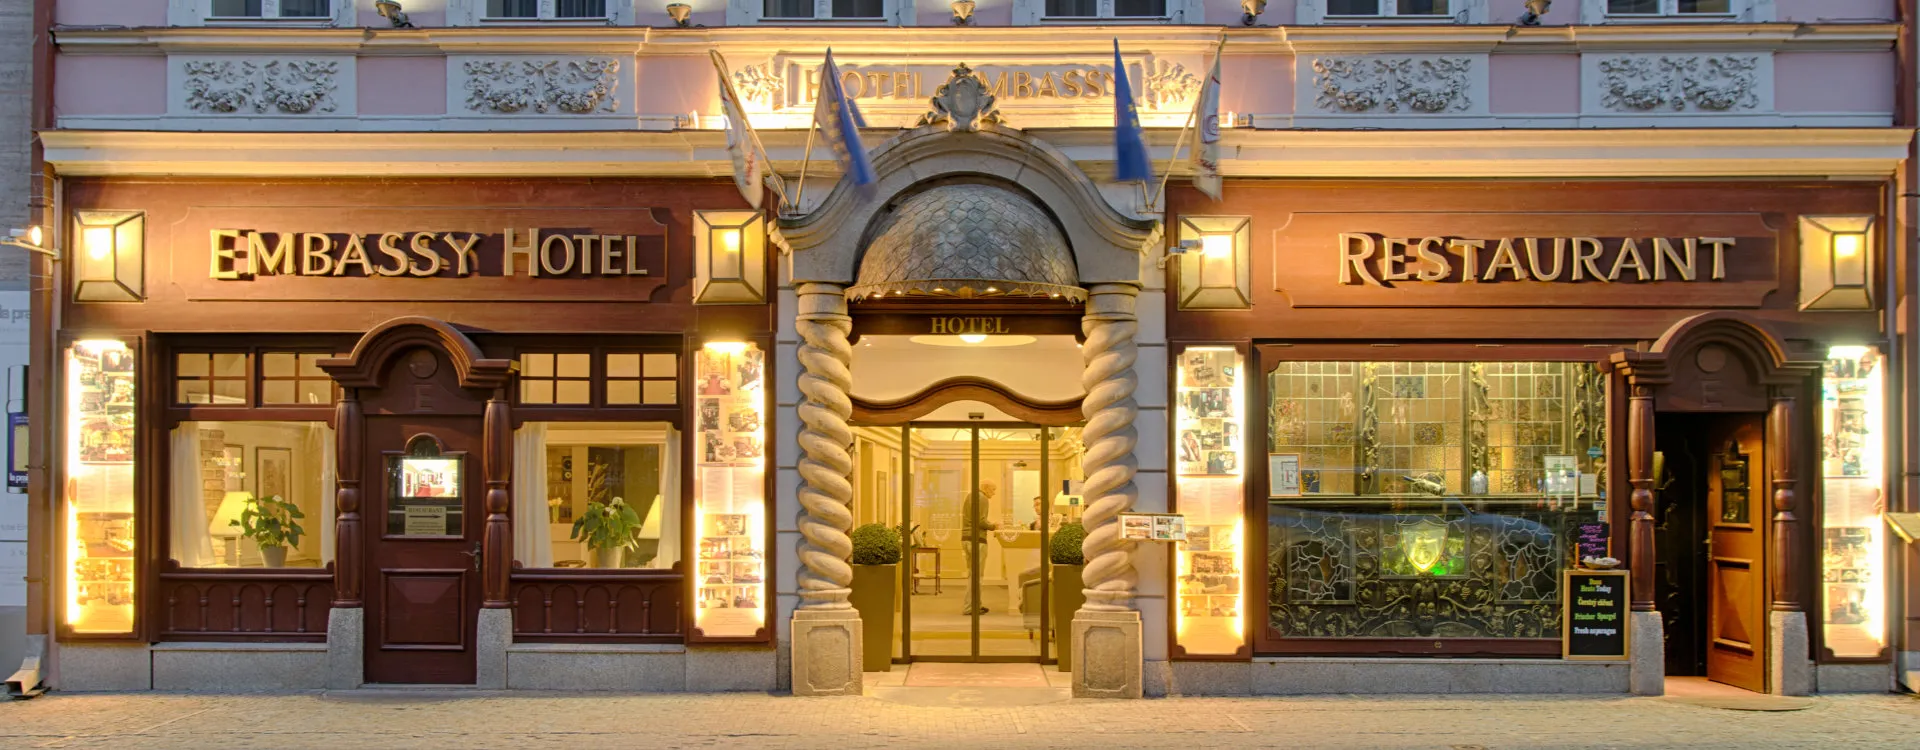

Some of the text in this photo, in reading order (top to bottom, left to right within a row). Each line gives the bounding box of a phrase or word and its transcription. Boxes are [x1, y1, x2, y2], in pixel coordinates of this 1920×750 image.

[209, 227, 648, 281] EMBASSY HOTEL
[1338, 232, 1736, 287] RESTAURANT
[929, 316, 1010, 334] HOTEL
